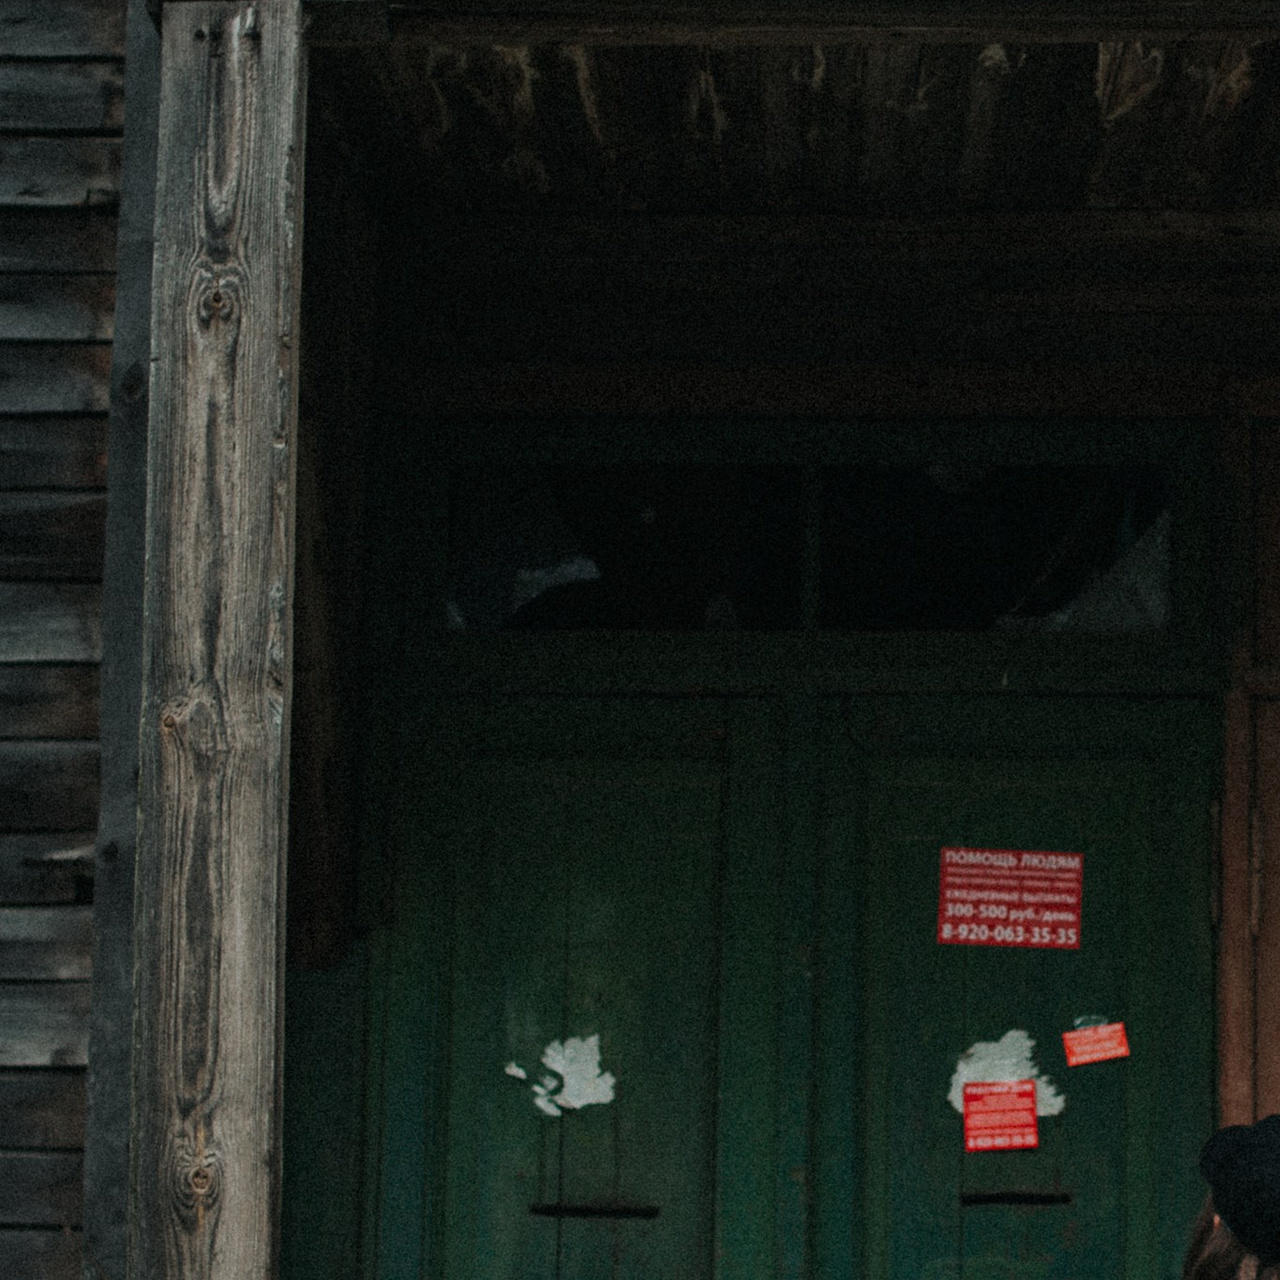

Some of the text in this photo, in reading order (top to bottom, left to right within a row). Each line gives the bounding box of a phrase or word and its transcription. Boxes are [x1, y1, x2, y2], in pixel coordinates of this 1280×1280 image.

[945, 850, 1080, 870] ПОМОЩЬ ЛЮДЯМ
[945, 903, 1007, 919] 300-500
[942, 923, 1077, 945] 8-920-063-35-35
